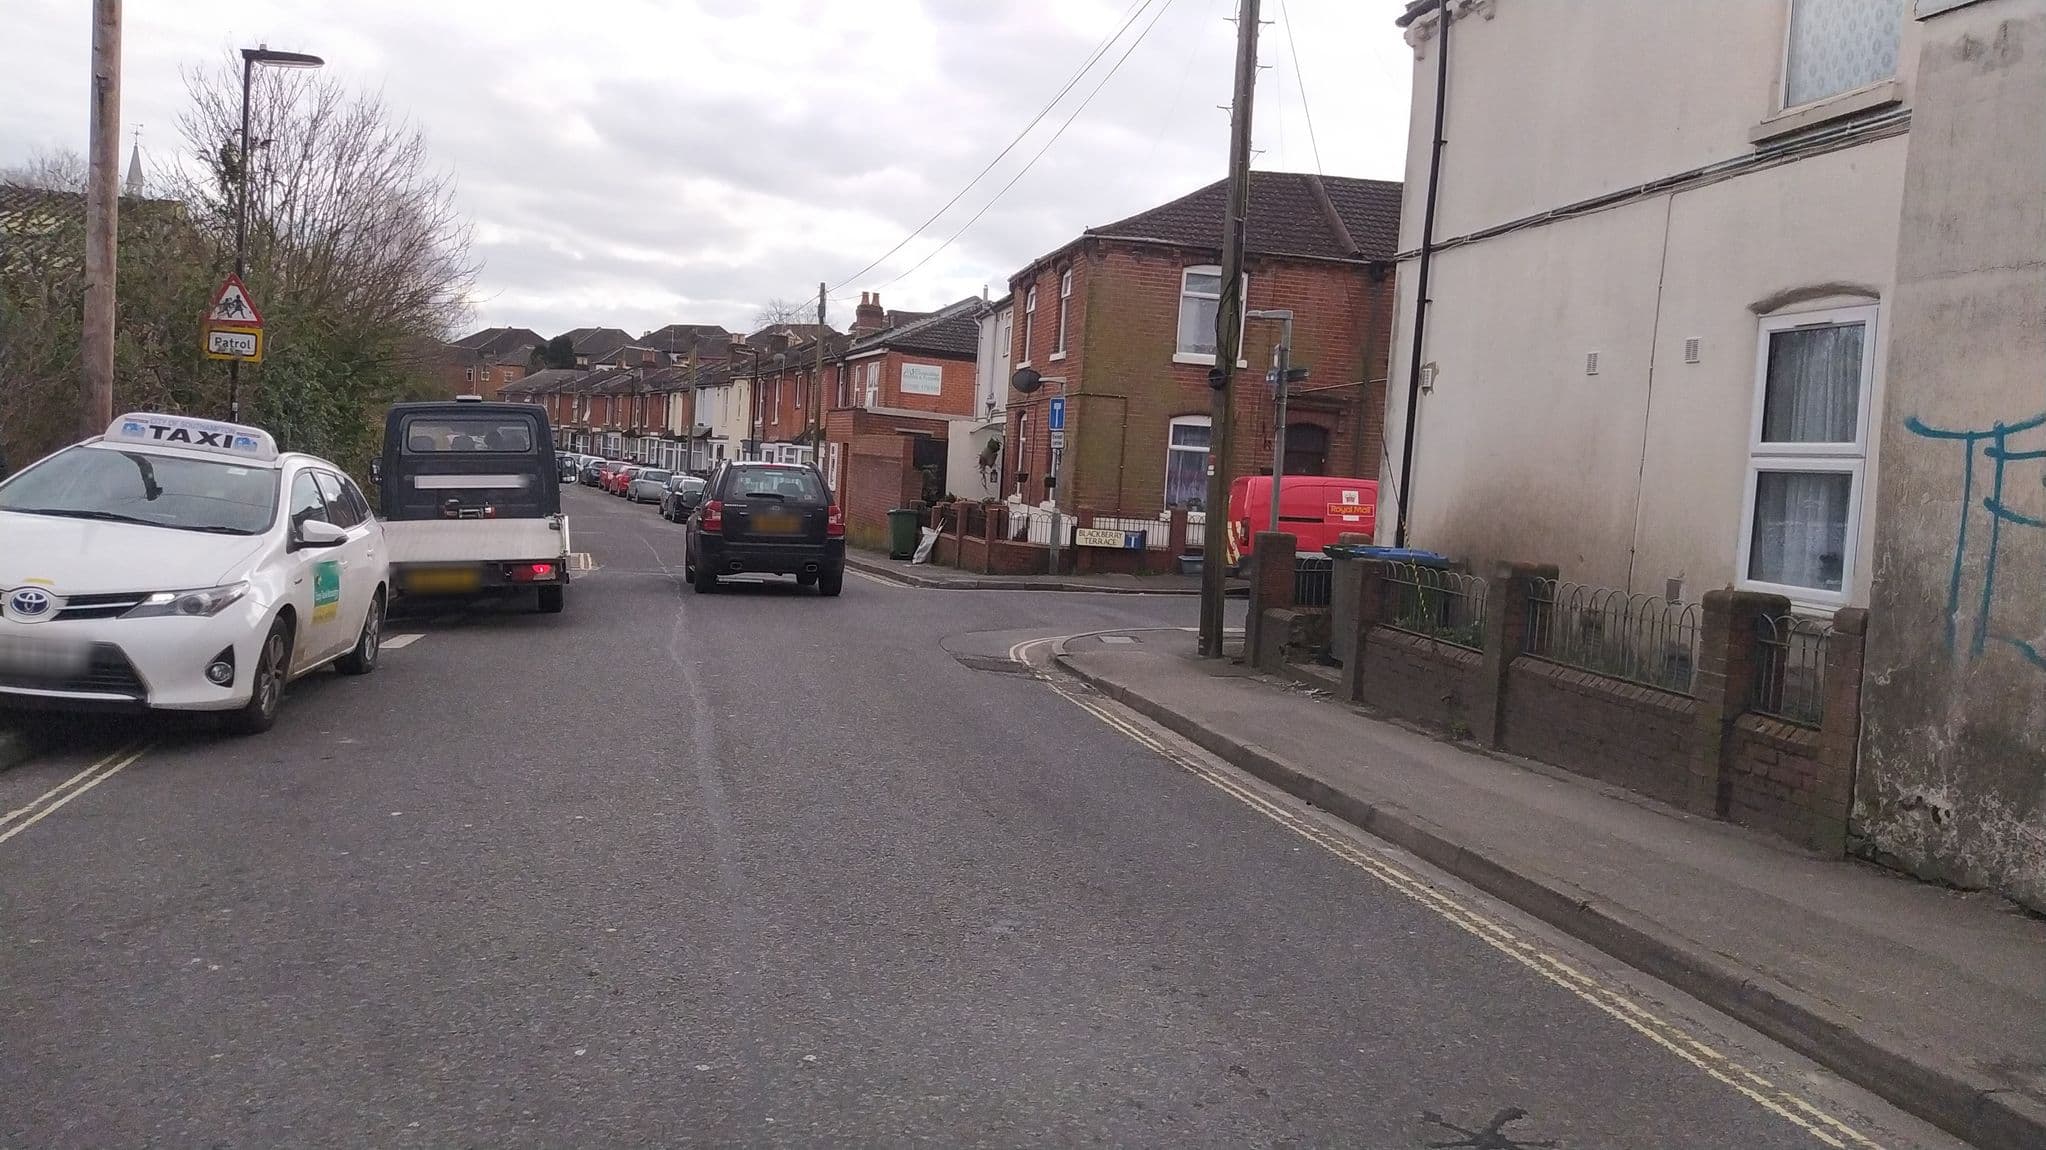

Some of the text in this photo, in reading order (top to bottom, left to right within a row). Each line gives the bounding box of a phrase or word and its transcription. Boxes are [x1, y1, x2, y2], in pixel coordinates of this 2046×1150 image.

[214, 337, 251, 350] Patrol
[149, 425, 234, 449] TAXI
[1330, 505, 1371, 515] Royal Mail
[1078, 529, 1122, 539] BLACKBERRY
[1085, 537, 1118, 545] TERRACE
